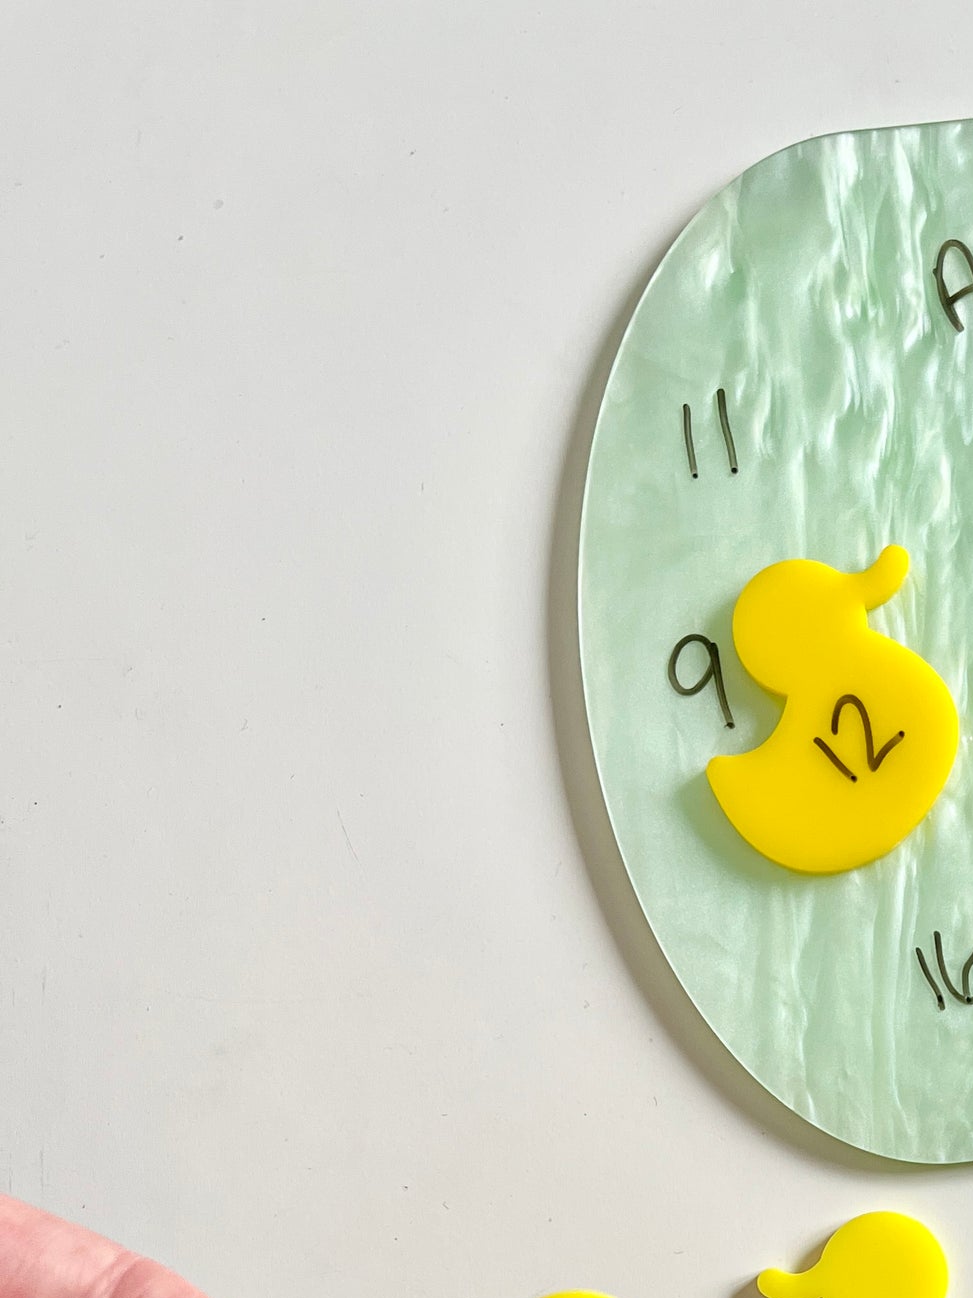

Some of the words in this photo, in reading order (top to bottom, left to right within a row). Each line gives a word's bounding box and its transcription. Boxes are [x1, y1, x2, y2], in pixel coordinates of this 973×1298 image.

[683, 388, 738, 479] 11
[668, 632, 735, 729] 9
[814, 693, 904, 783] 12
